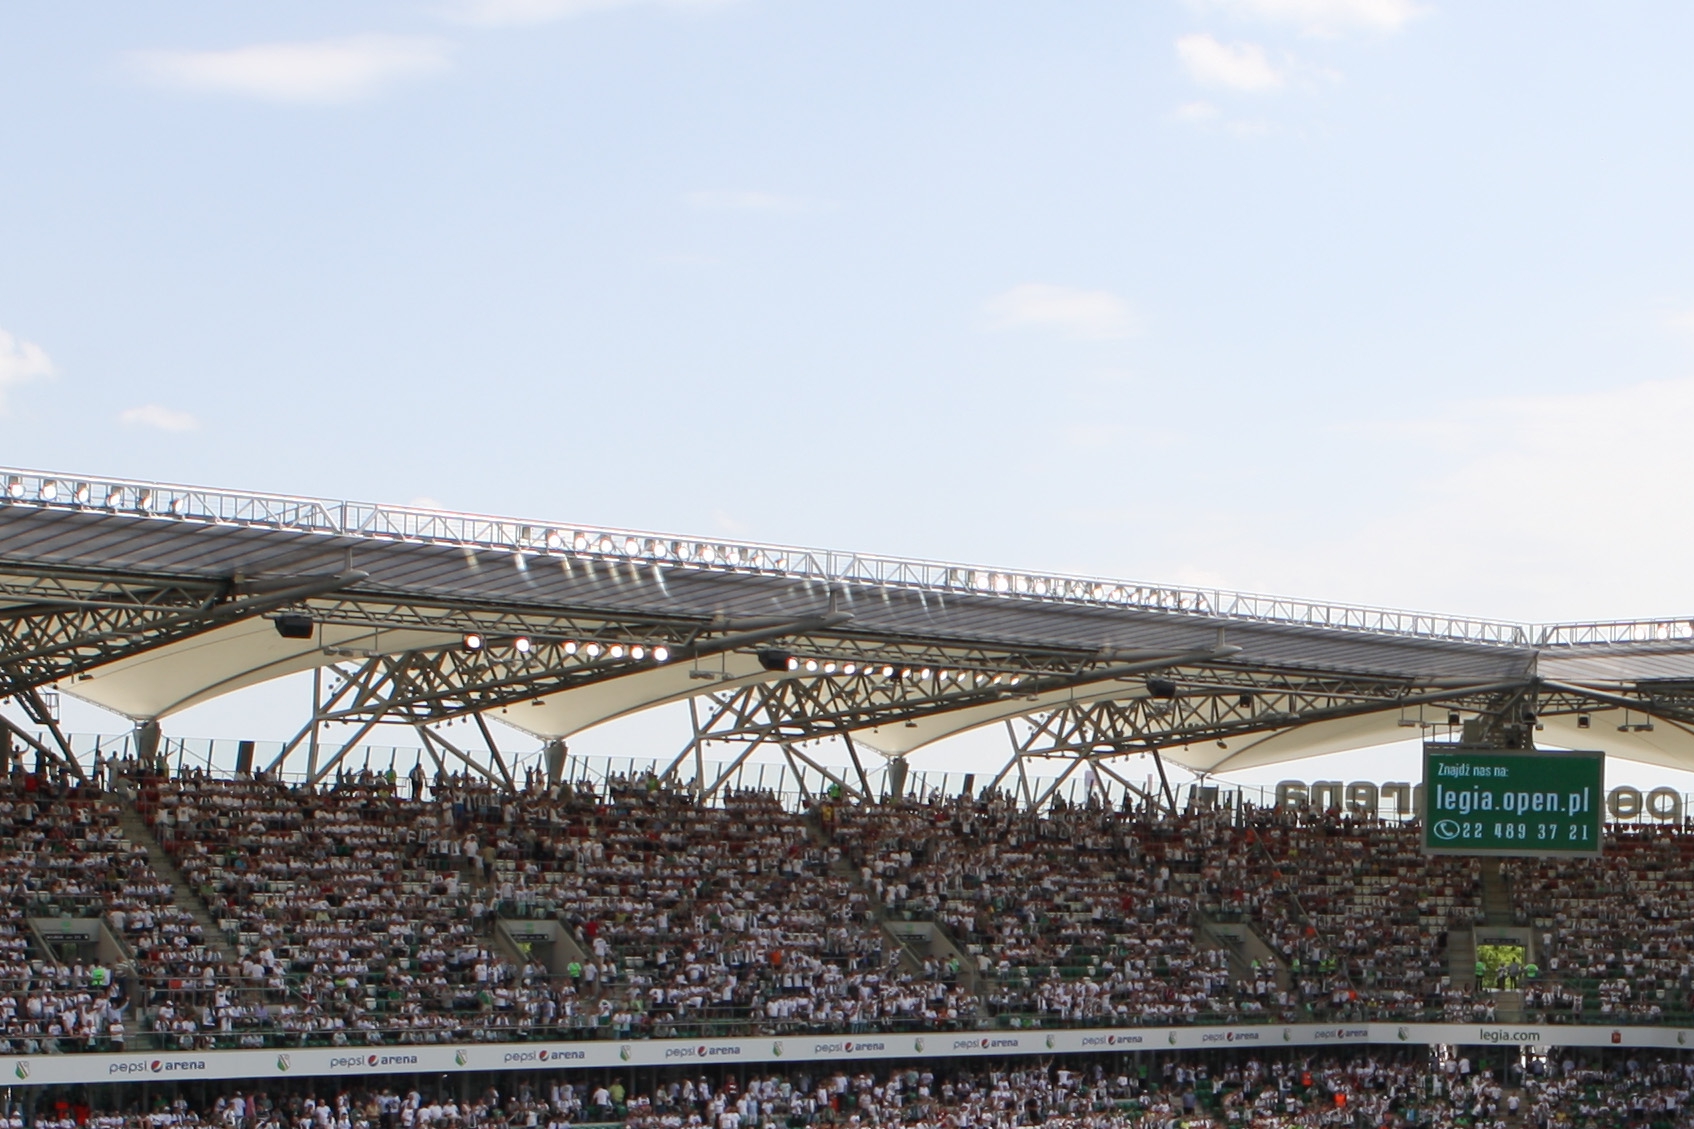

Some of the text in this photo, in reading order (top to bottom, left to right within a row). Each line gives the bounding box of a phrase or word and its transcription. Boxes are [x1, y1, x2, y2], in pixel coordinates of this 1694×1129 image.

[1473, 766, 1491, 777] nas
[1494, 766, 1509, 777] na:
[1436, 784, 1589, 816] legia.open.pl
[1462, 822, 1588, 841] 22 489 37 21
[1480, 1028, 1540, 1044] legia.com
[504, 1051, 585, 1064] pepsi arena
[666, 1047, 740, 1059] pepsi arena
[109, 1061, 205, 1075] pepsi arena
[330, 1056, 417, 1069] pepsi arena
